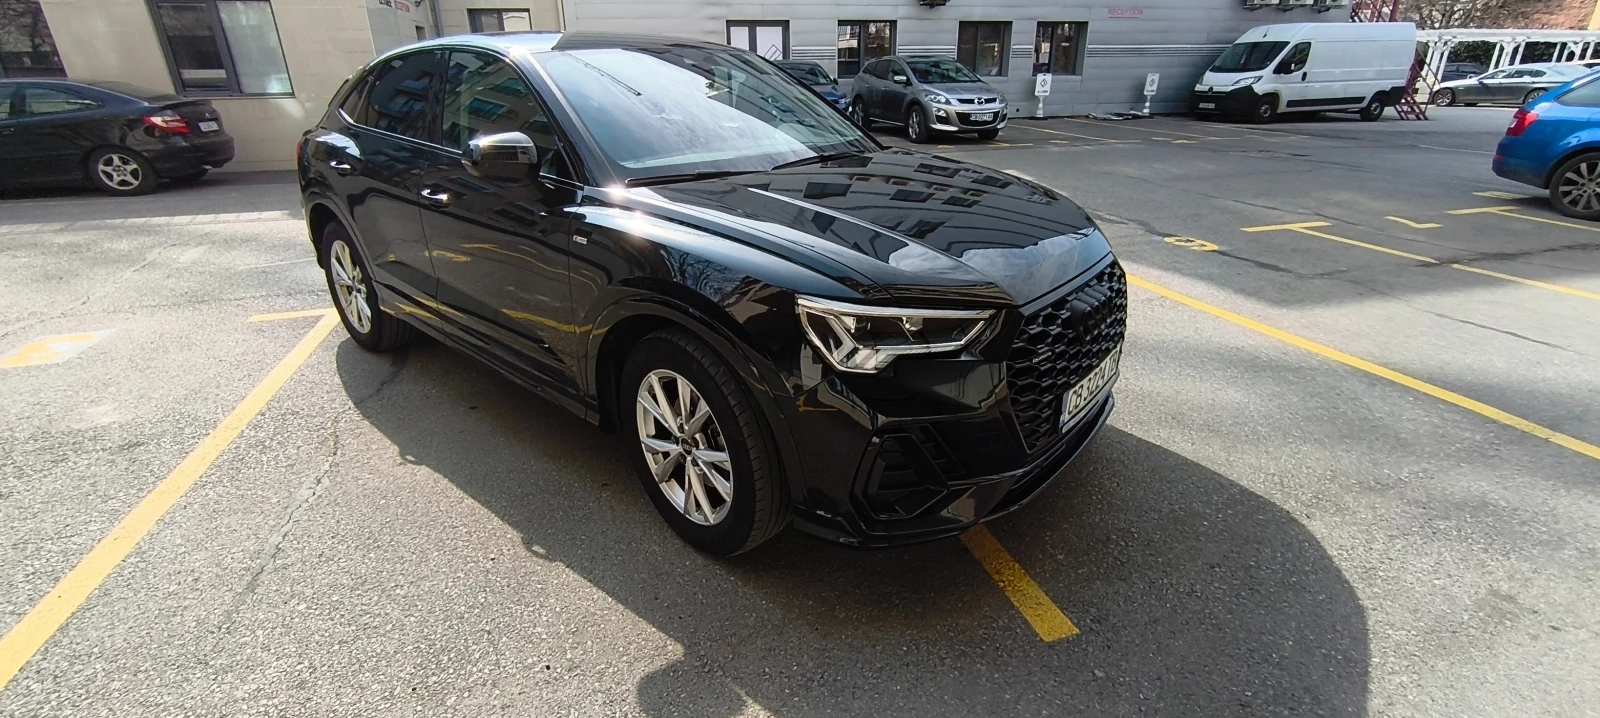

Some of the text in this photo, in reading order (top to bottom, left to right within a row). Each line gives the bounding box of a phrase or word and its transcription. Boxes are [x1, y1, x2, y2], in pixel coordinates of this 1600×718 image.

[1108, 8, 1144, 16] RECEPTION
[1068, 384, 1084, 415] CB
[1083, 361, 1107, 402] 3224
